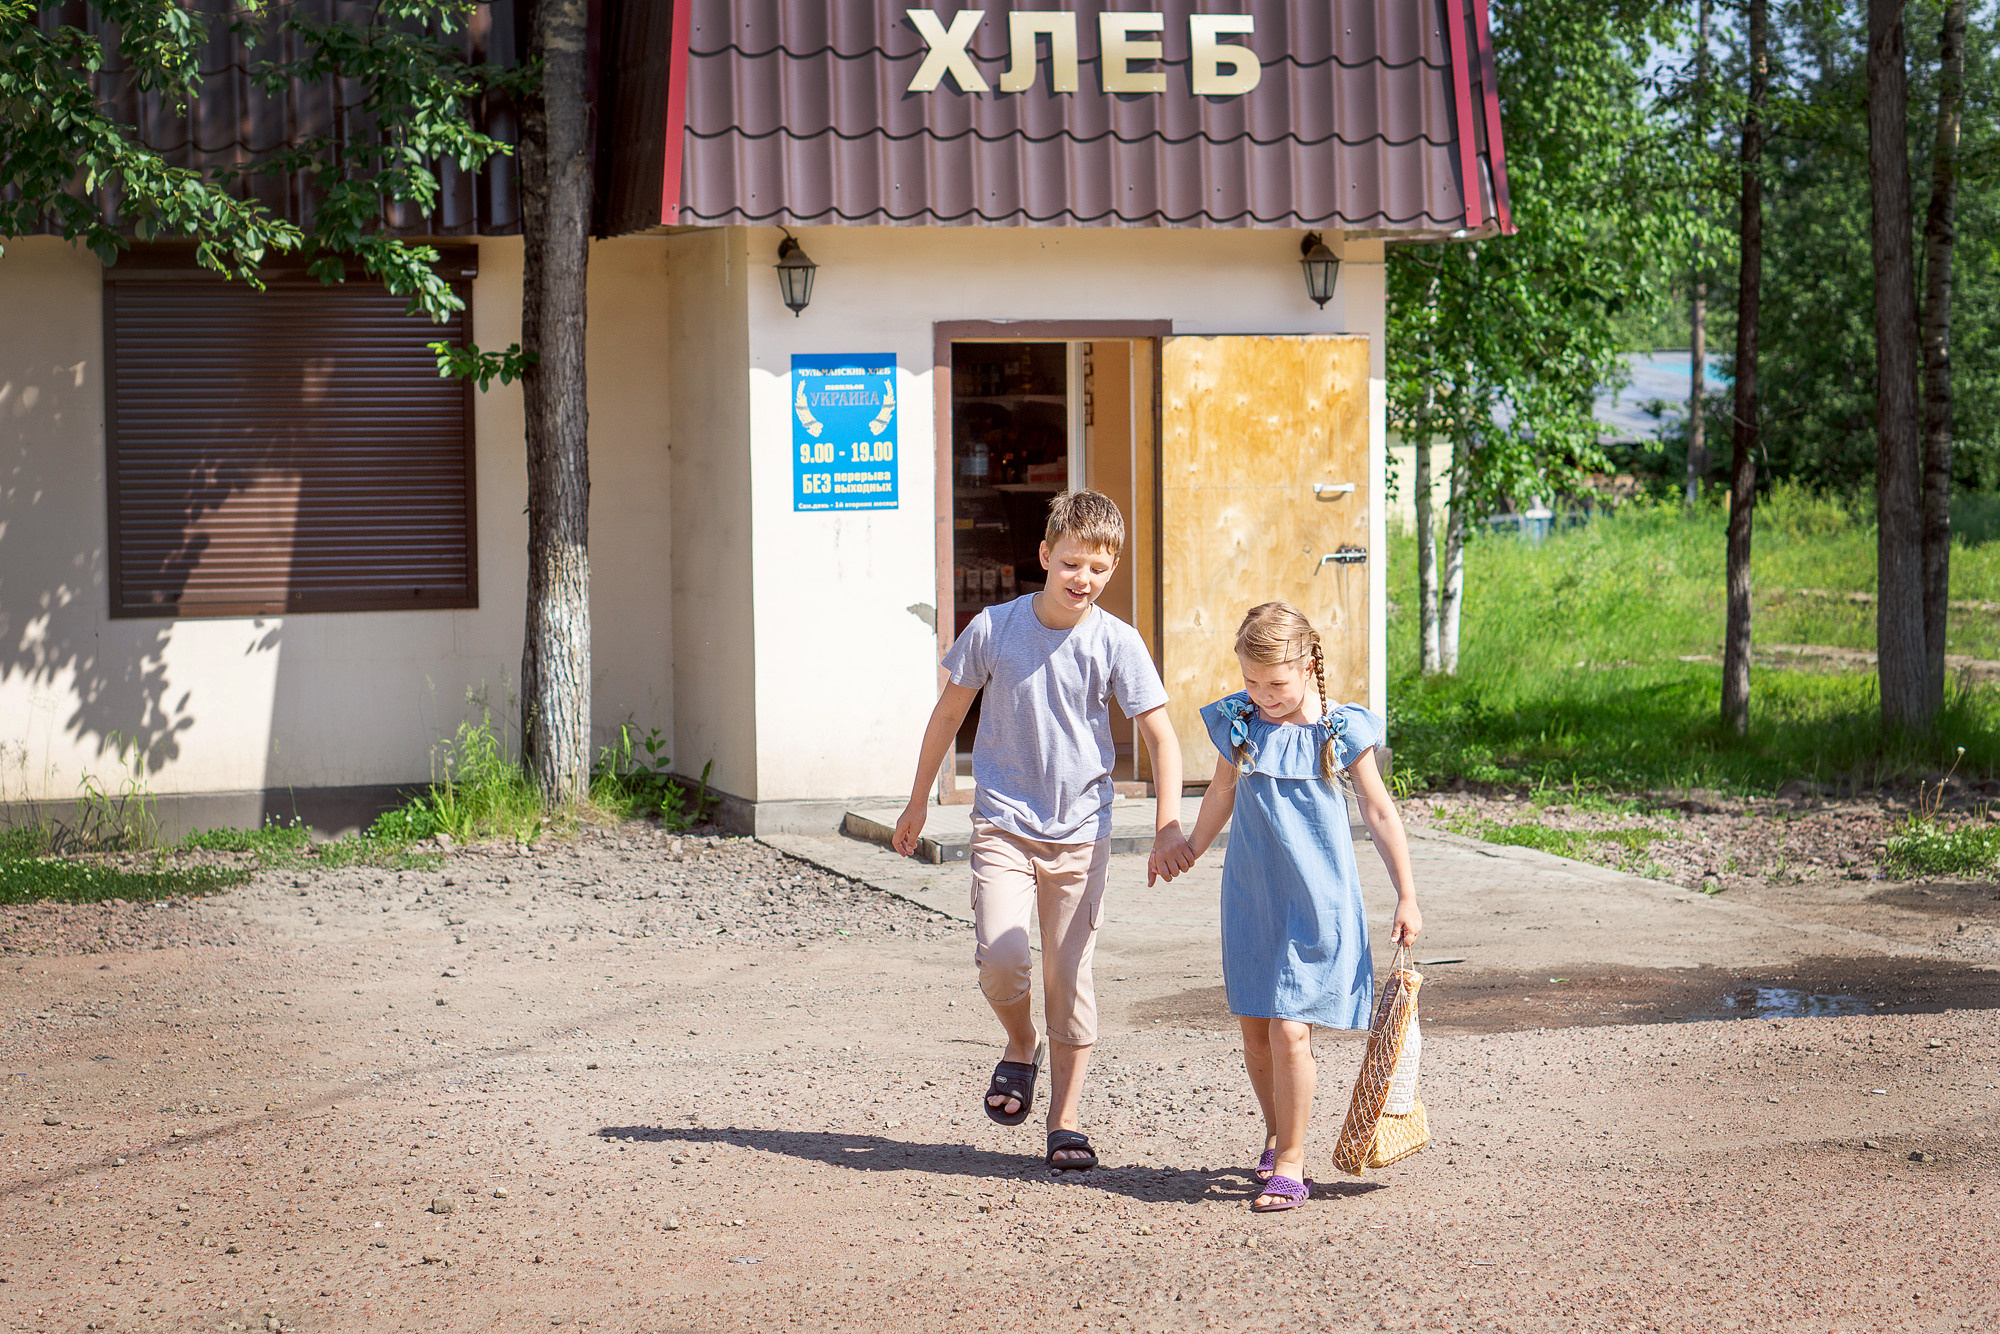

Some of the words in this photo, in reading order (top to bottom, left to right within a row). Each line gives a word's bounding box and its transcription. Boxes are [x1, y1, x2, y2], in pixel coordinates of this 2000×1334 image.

[906, 9, 1261, 95] ХЛЕБ
[867, 367, 891, 375] ХЛЕБ
[810, 391, 880, 406] УКРАИНА
[800, 443, 834, 463] 9.00
[851, 441, 893, 462] 19.00
[802, 473, 831, 493] БЕЗ
[834, 471, 891, 483] перерыва
[834, 483, 892, 493] выходных
